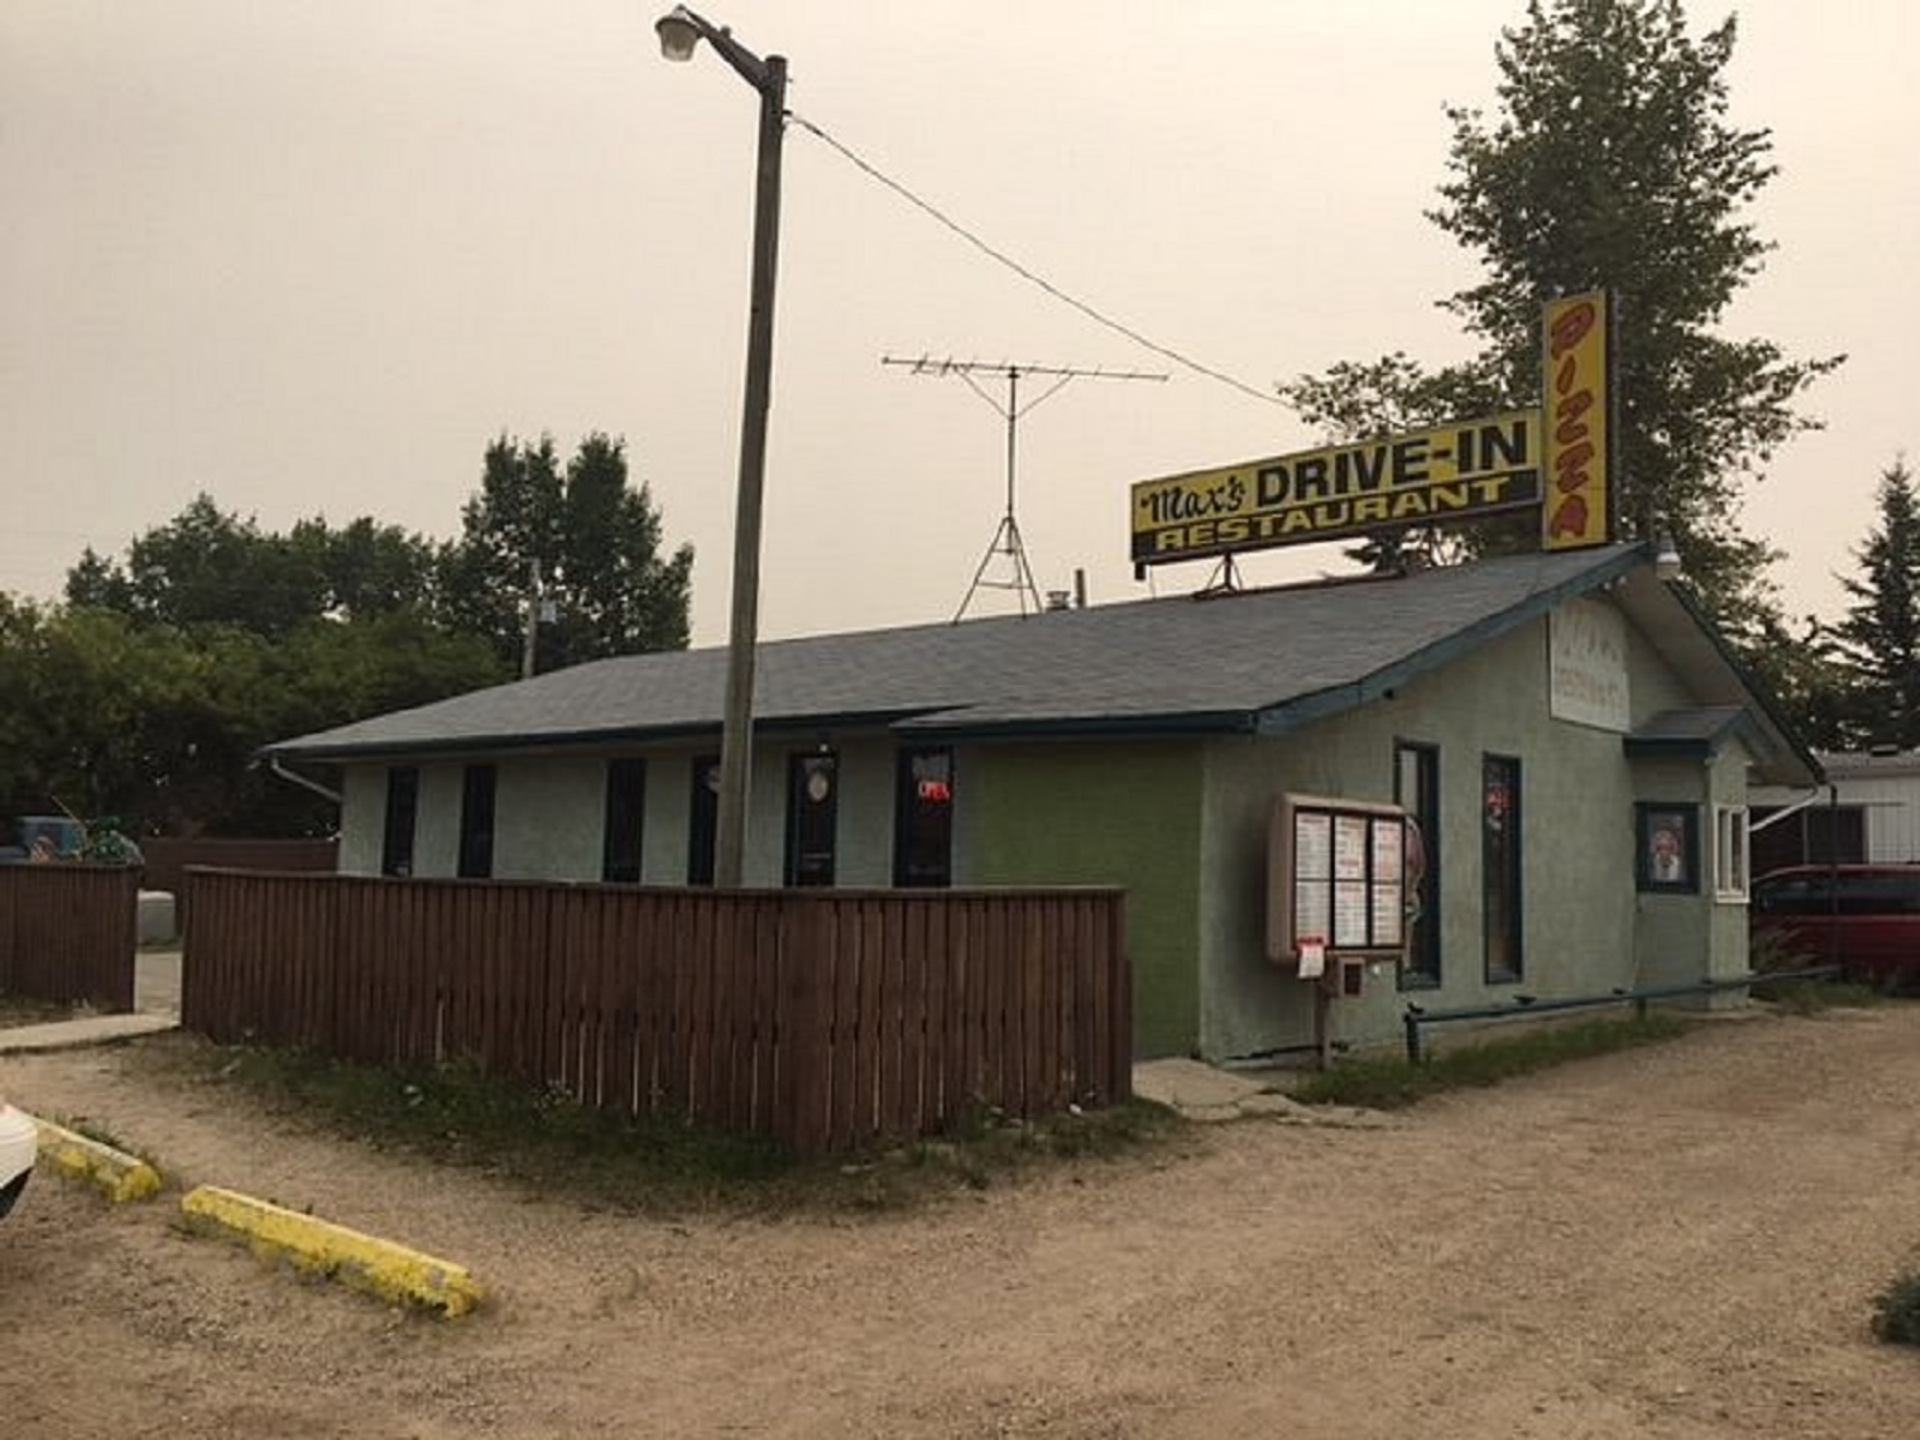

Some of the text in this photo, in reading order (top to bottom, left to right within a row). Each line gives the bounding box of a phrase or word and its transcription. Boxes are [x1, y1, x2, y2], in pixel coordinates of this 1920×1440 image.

[1142, 420, 1528, 522] Max's DRIVE-IN
[1156, 477, 1511, 550] RESTAURANT
